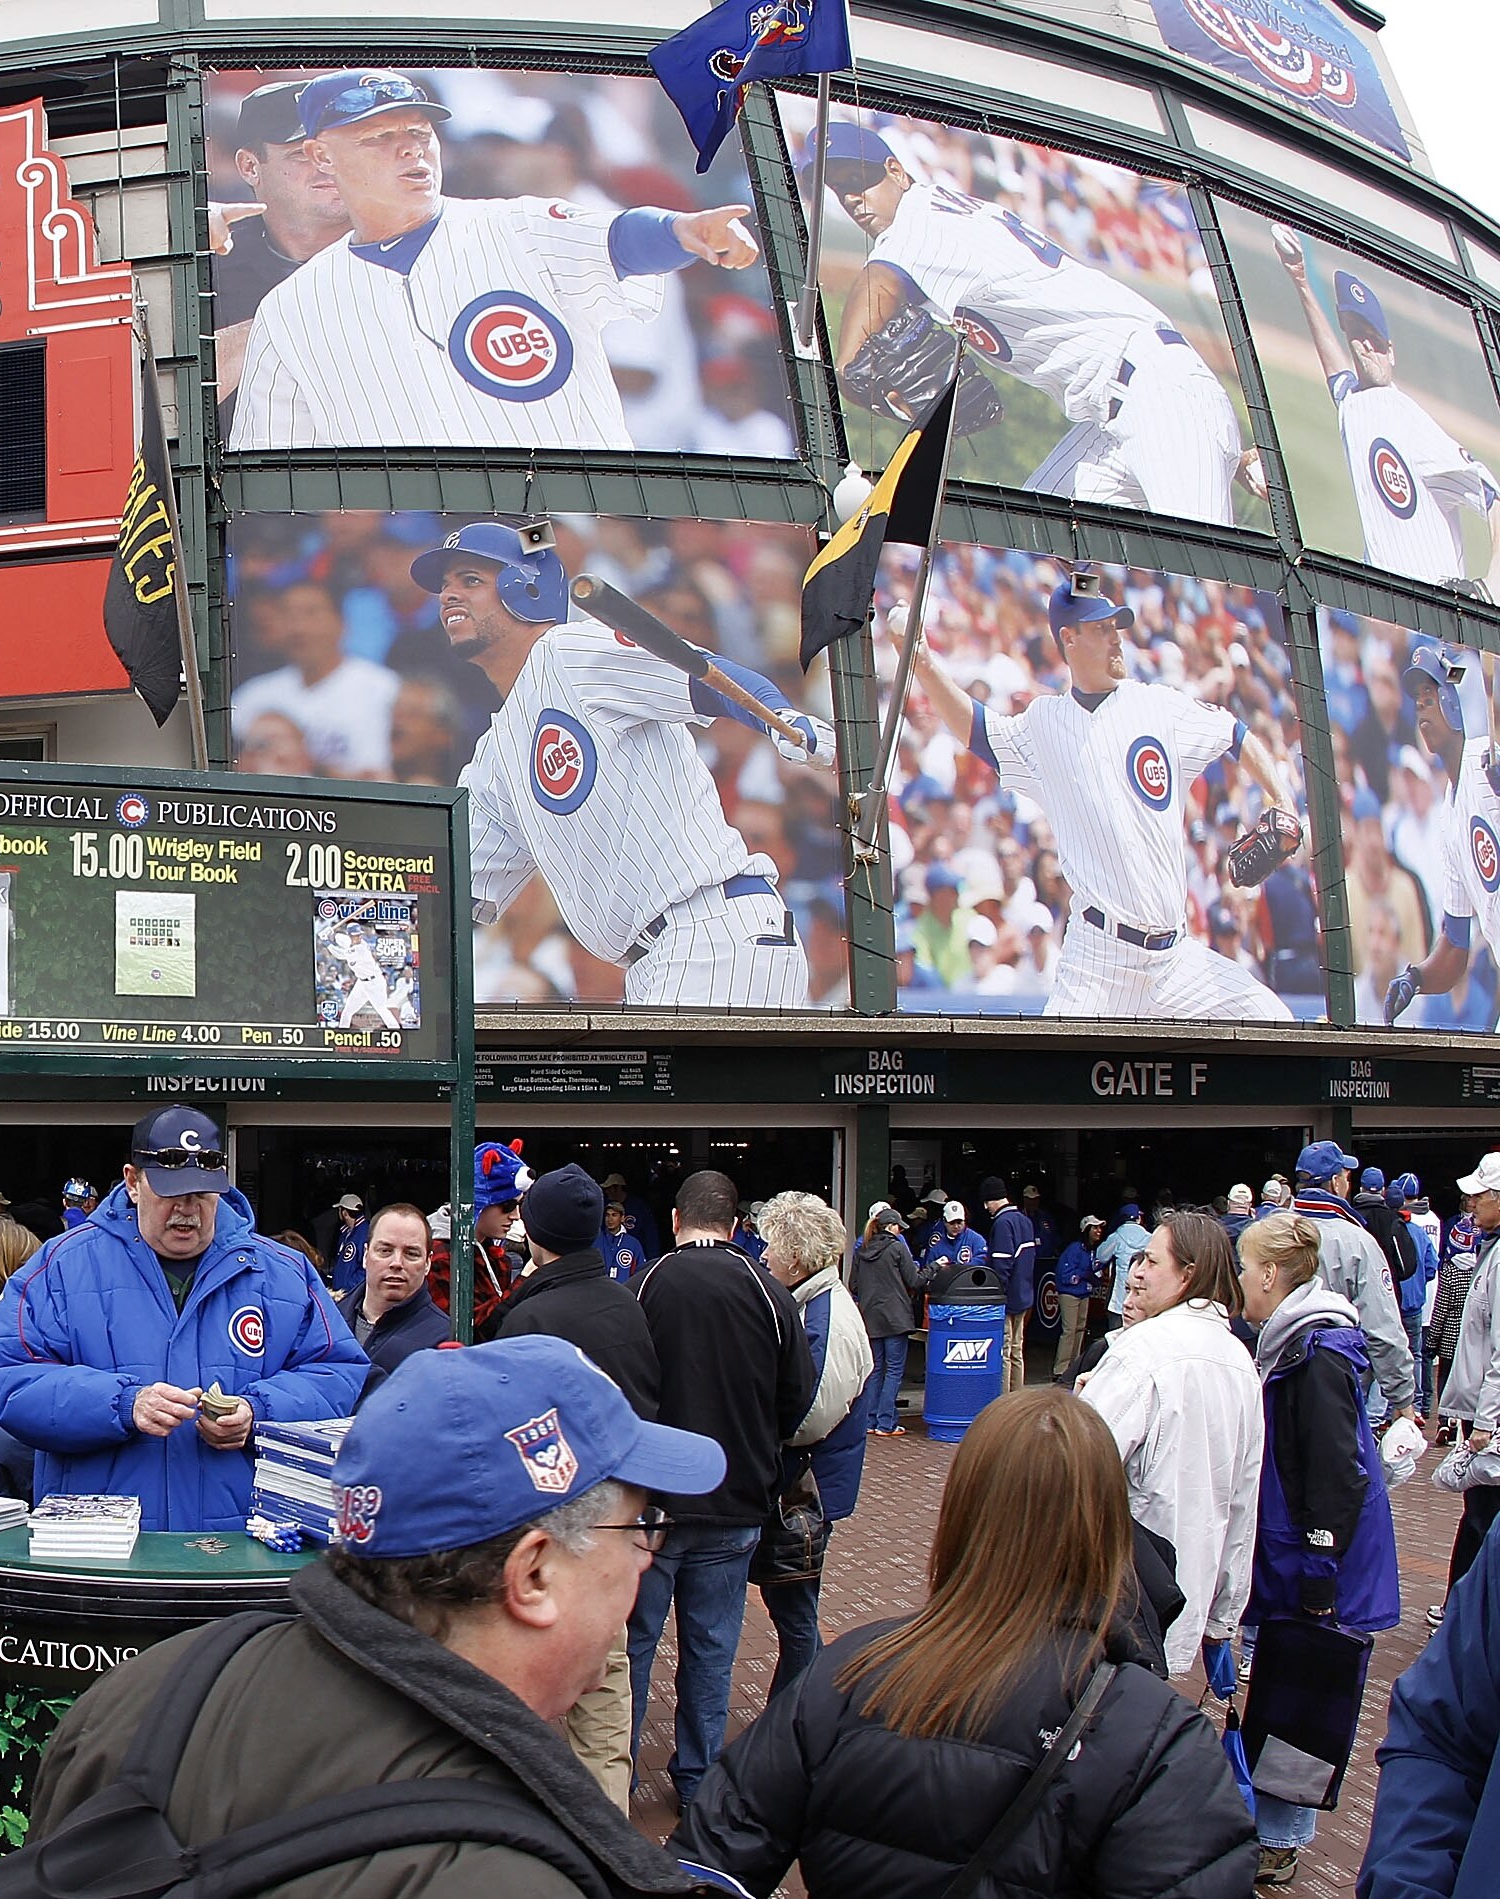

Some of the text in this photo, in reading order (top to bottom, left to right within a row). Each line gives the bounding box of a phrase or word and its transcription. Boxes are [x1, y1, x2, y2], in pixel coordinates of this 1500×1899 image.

[156, 801, 337, 833] PUBLICATIONS
[69, 831, 262, 881] 15.00 Wrigley Field
[285, 842, 435, 890] 2.00 Scorecard
[145, 859, 239, 885] Tour Book
[343, 871, 407, 893] EXTRA
[375, 945, 408, 958] SOPH
[376, 937, 405, 947] SUPER
[27, 1021, 81, 1040] 15.00
[101, 1023, 138, 1042] Vine
[141, 1025, 177, 1043] Line
[181, 1025, 222, 1044] 4.00
[241, 1027, 273, 1044] Pen
[276, 1028, 304, 1045] .50
[323, 1028, 372, 1047] Pencil
[375, 1031, 403, 1048] .50
[868, 1050, 904, 1071] BAG
[1350, 1060, 1372, 1079] BAG
[146, 1076, 266, 1092] INSPECTION
[834, 1073, 935, 1095] INSPECTION
[1090, 1060, 1208, 1097] GATE F
[1329, 1079, 1390, 1098] INSPECTION
[179, 1130, 201, 1151] C
